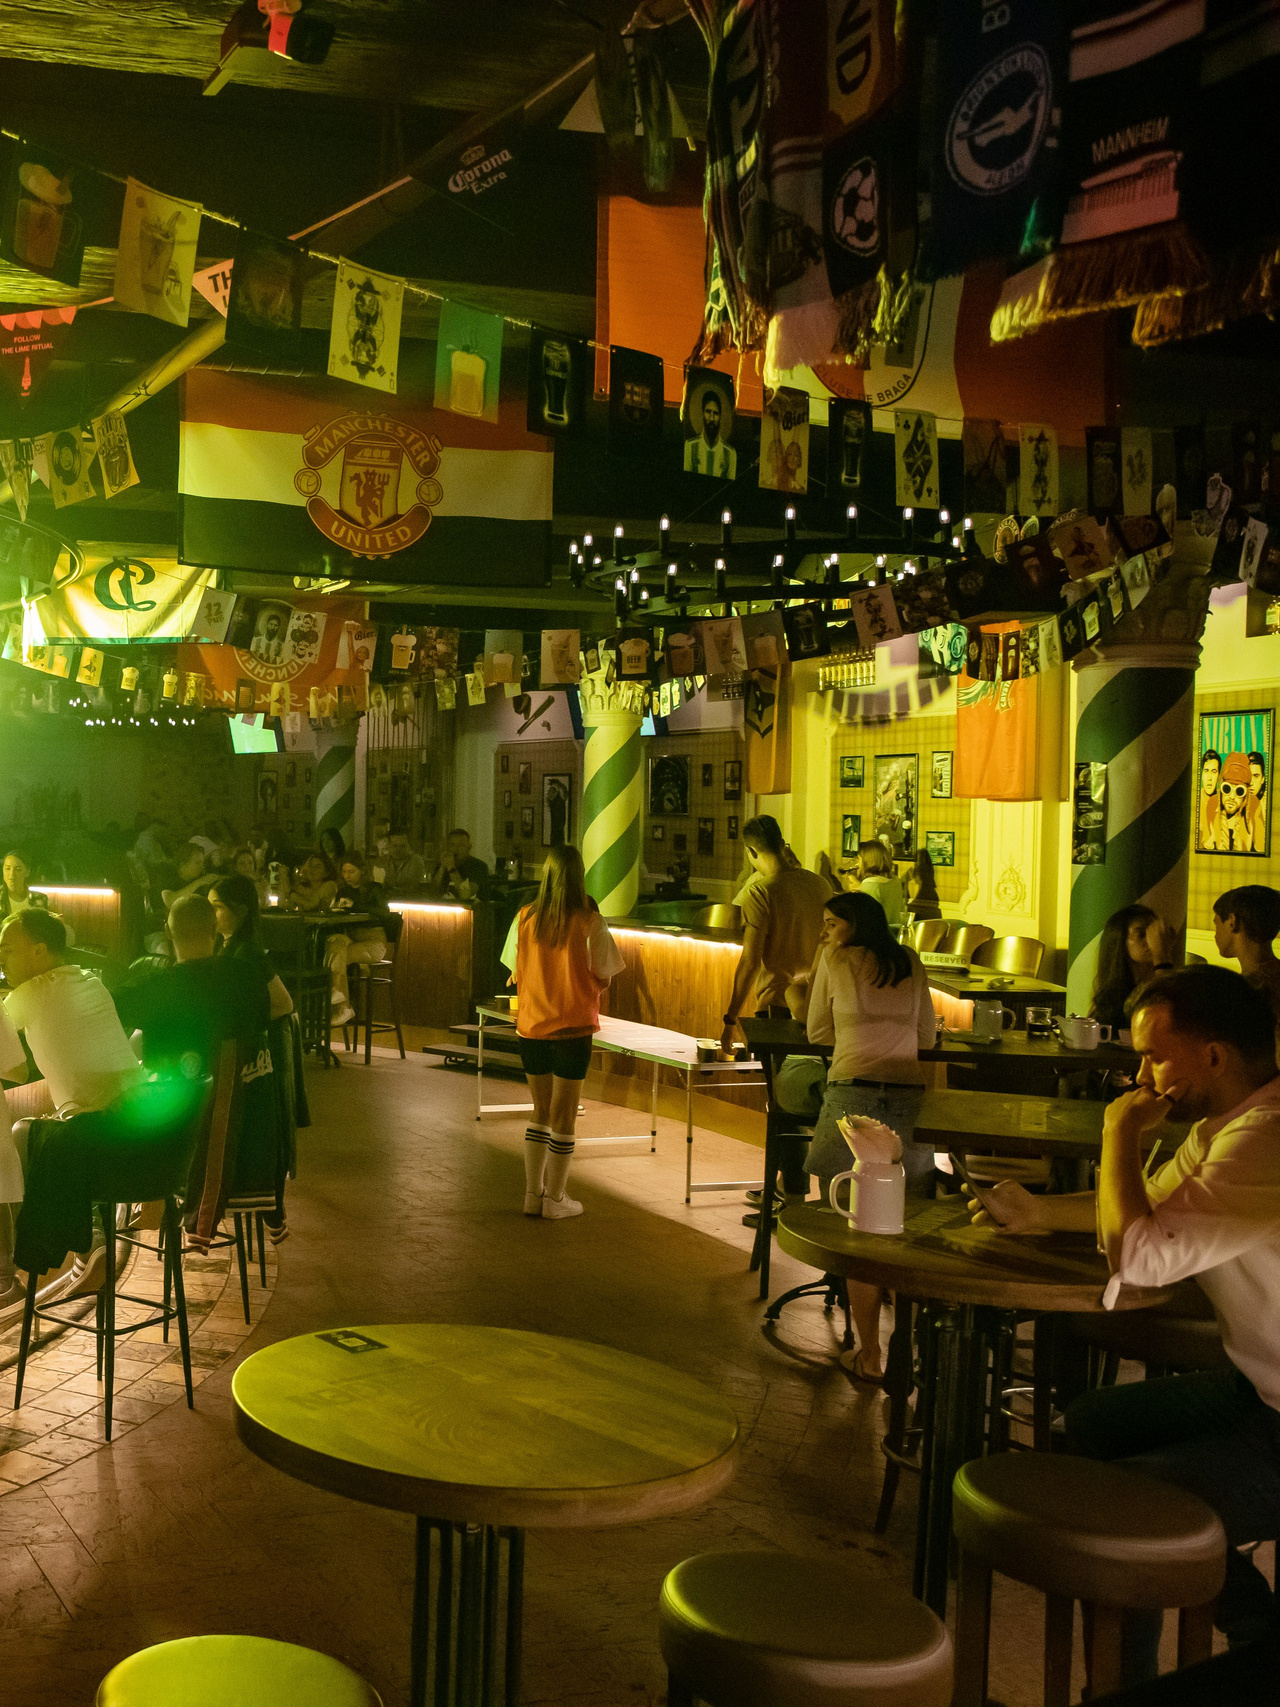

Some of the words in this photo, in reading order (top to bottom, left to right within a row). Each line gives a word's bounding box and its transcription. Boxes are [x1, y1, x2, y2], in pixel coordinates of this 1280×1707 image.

[1091, 116, 1170, 164] MANNHEIM
[448, 149, 512, 193] Corona
[470, 171, 507, 194] Extra
[1, 347, 14, 355] THE
[15, 345, 31, 353] LIME
[31, 342, 54, 351] RITUAL
[13, 334, 41, 344] FOLLOW
[877, 373, 911, 402] BRAGA
[314, 418, 431, 468] MANCHESTER
[331, 520, 412, 549] UNITED
[923, 954, 967, 965] RESERVED
